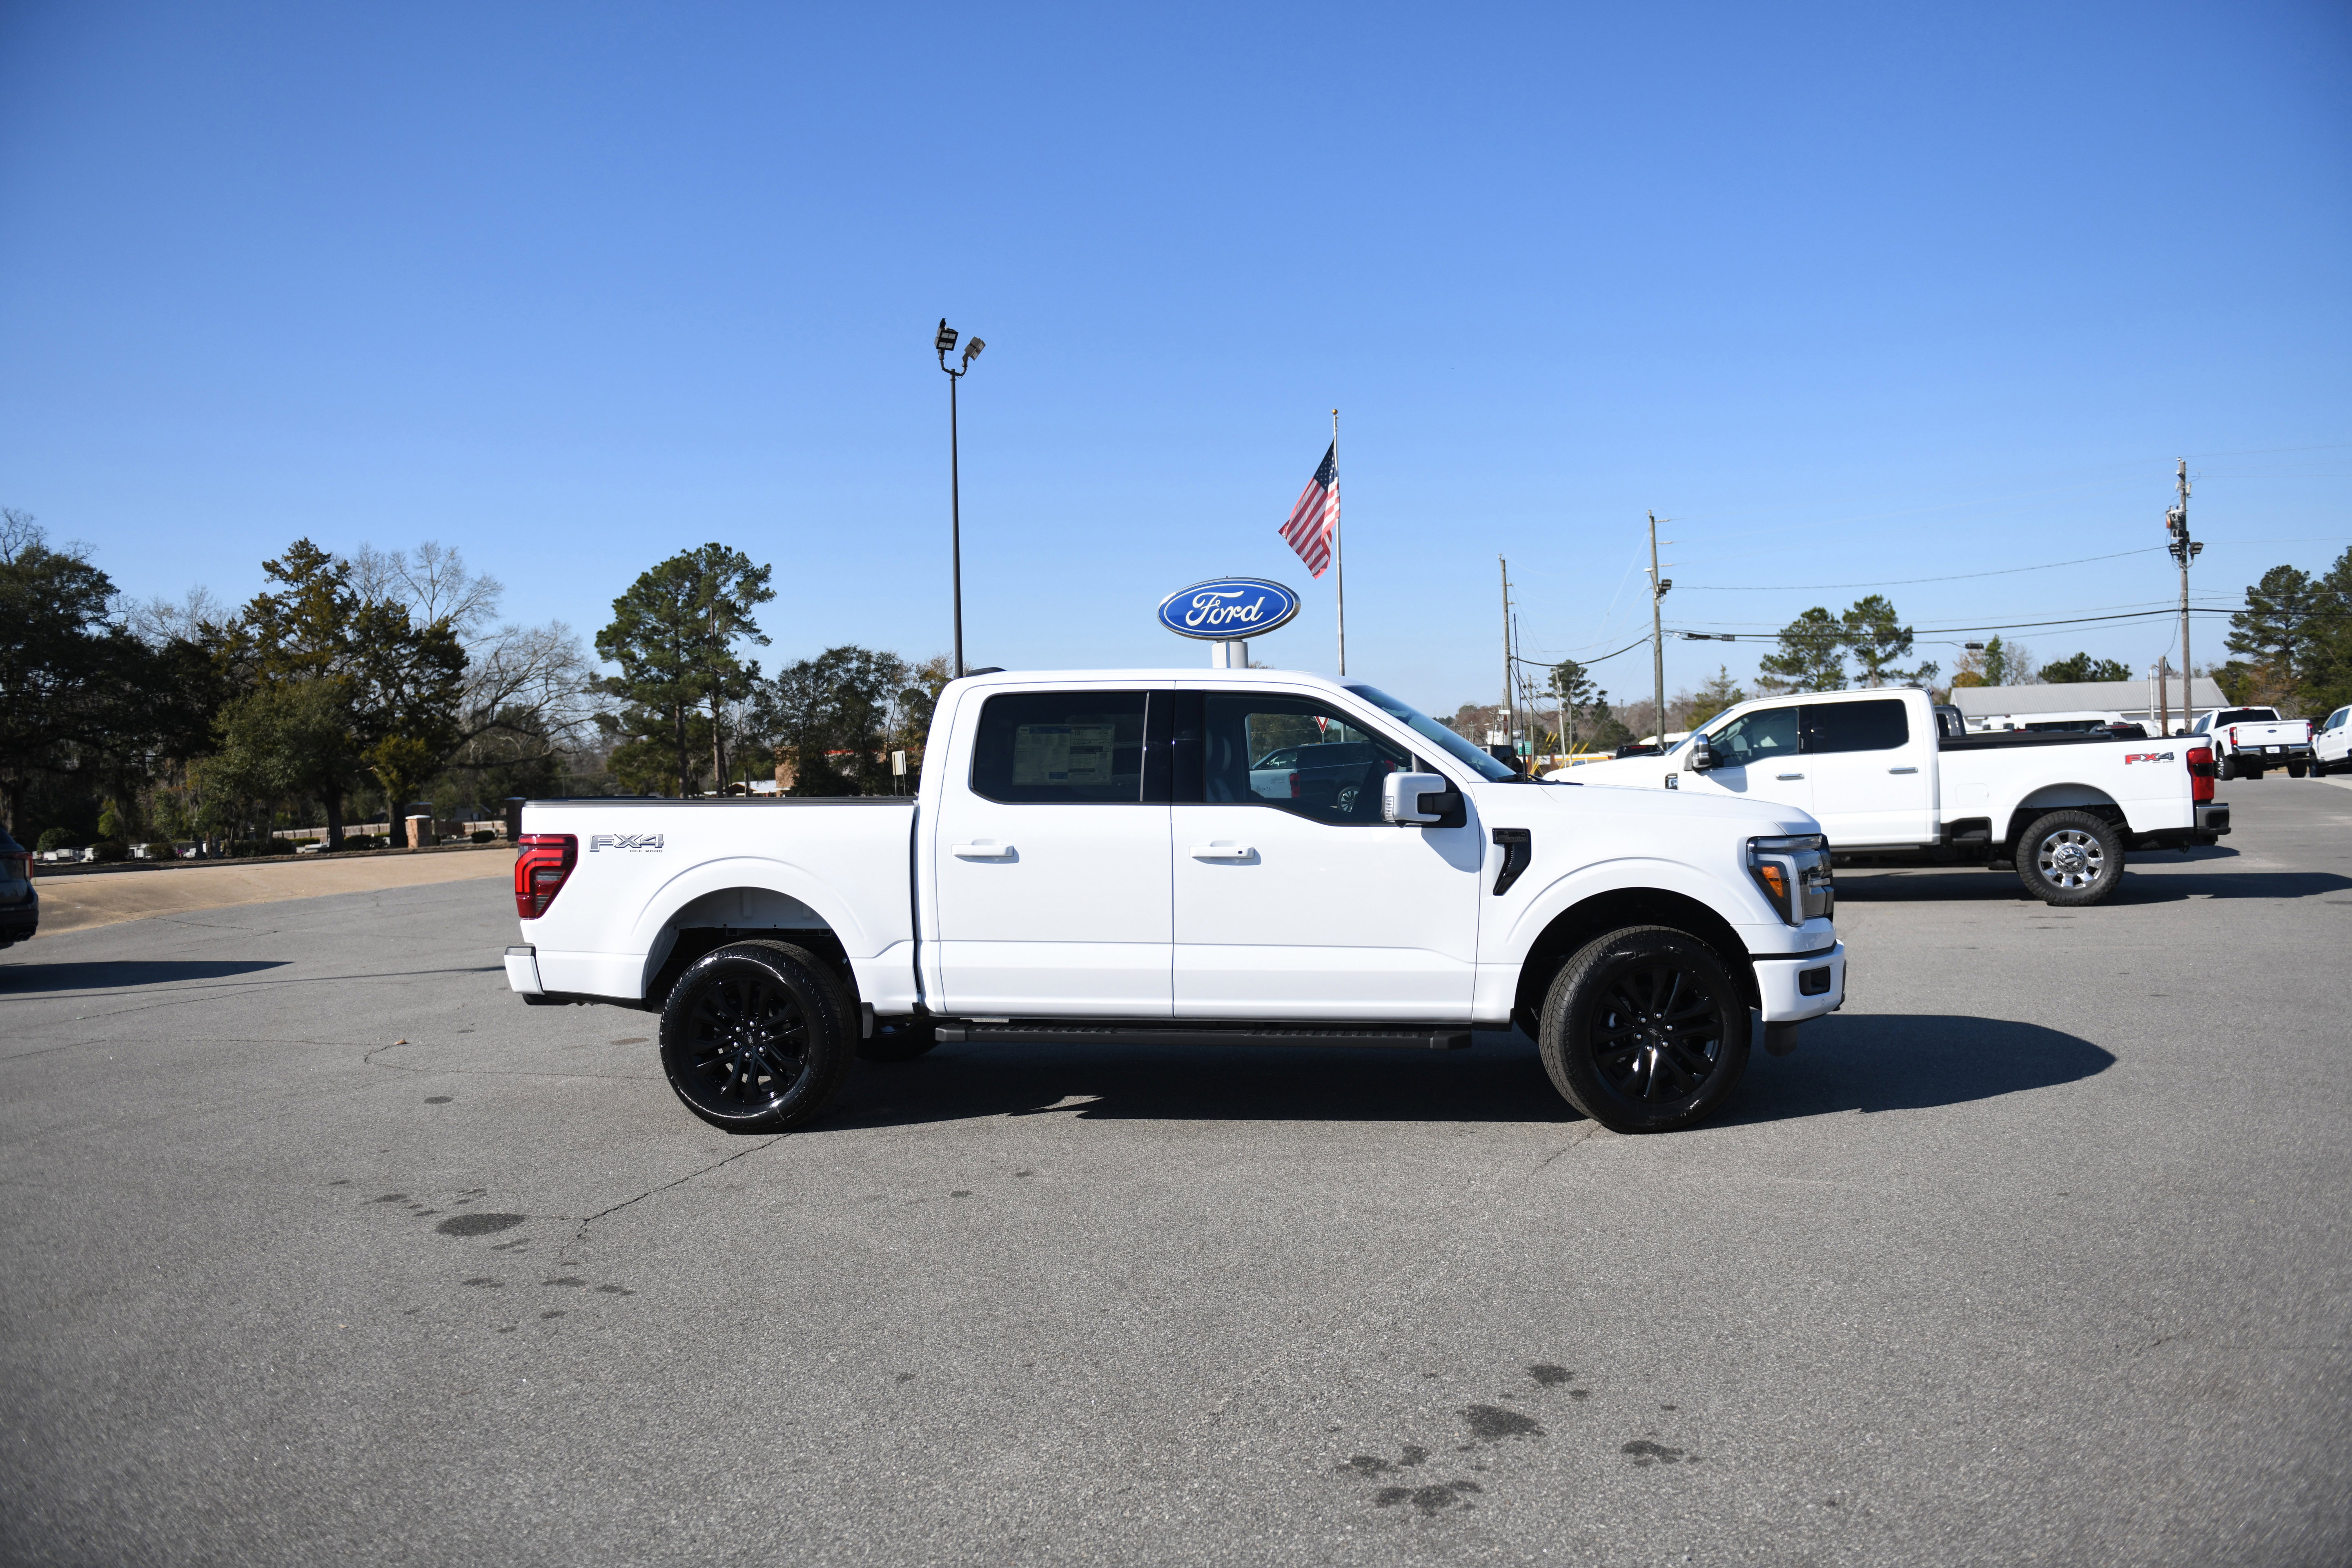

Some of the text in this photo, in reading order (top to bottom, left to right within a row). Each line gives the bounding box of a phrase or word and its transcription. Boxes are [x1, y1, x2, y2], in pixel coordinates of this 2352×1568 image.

[1185, 590, 1265, 626] Ford
[2125, 752, 2174, 765] FX4
[590, 834, 664, 852] FX4
